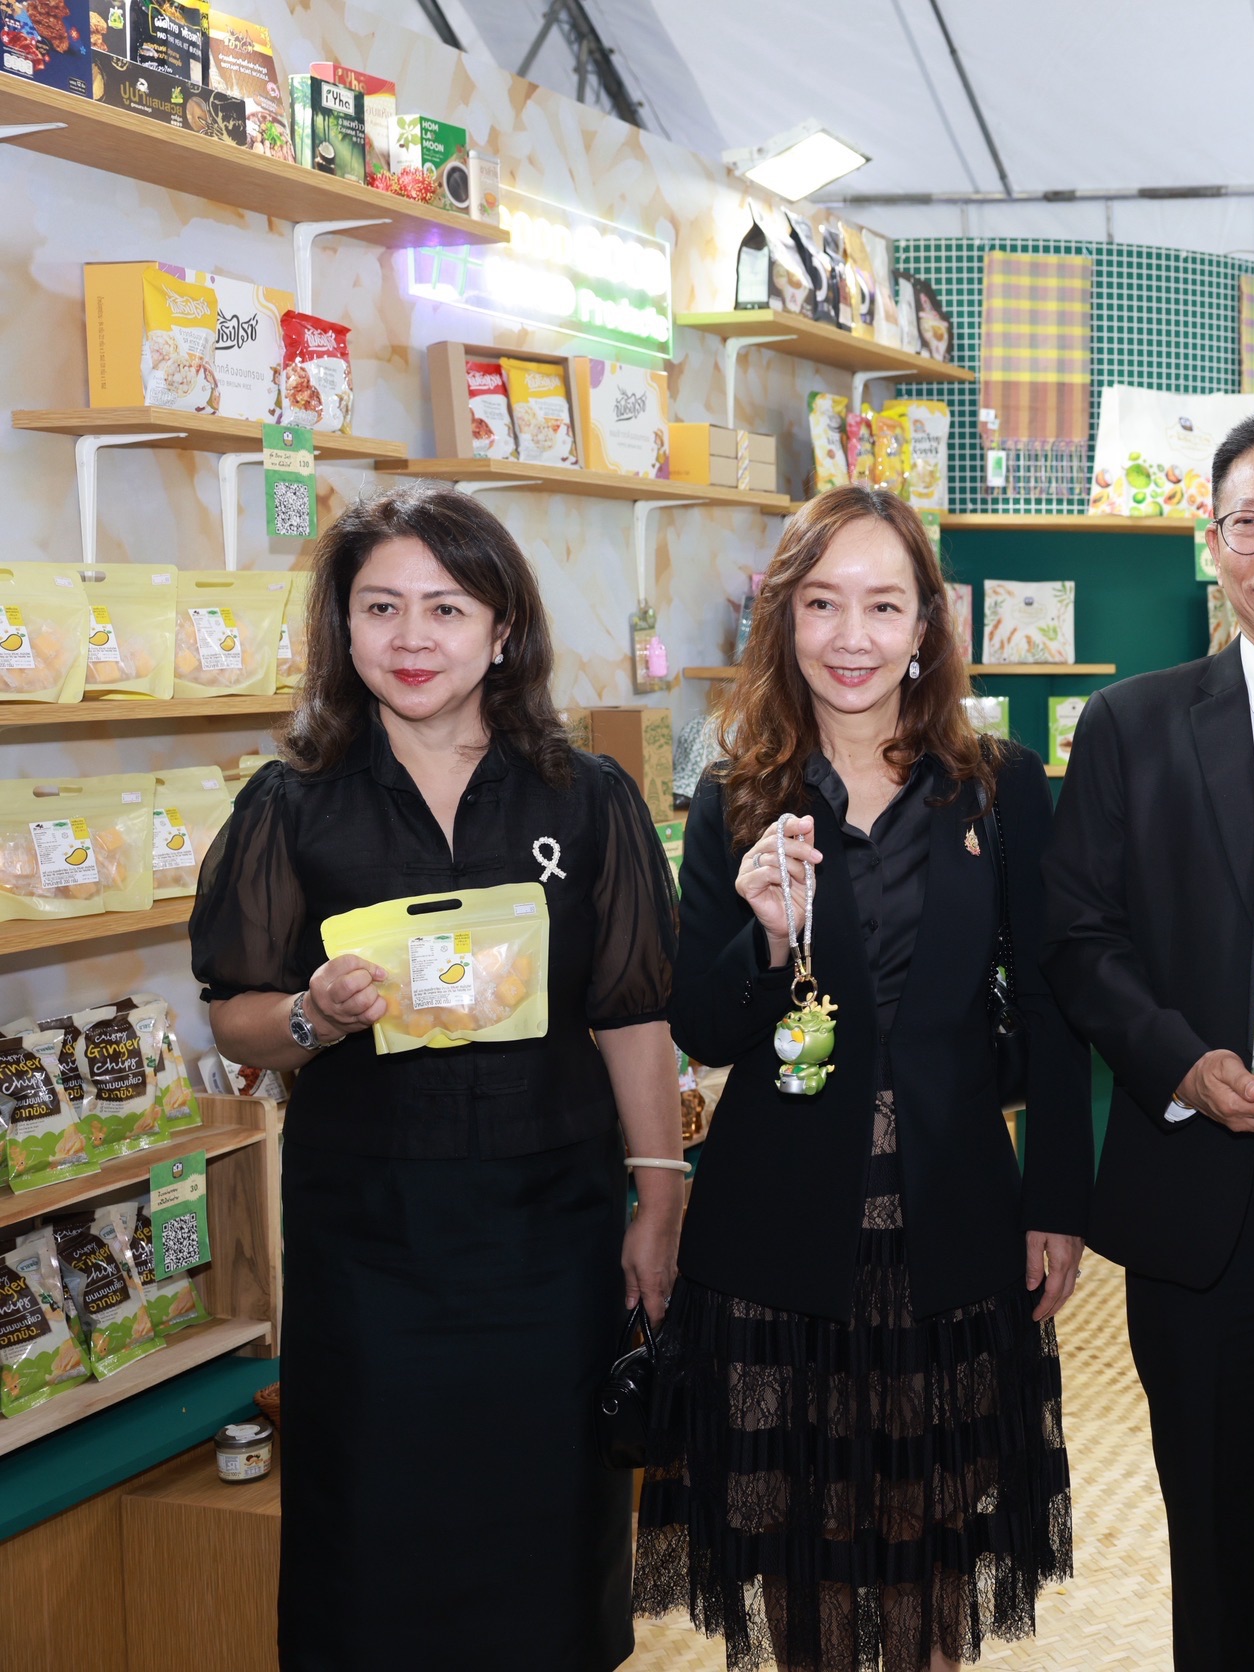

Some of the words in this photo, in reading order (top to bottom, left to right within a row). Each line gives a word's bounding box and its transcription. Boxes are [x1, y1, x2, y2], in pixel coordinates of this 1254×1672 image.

[422, 120, 439, 132] HOM
[422, 140, 444, 152] MOON
[87, 1036, 140, 1060] Ginger
[190, 1183, 198, 1193] 30
[71, 1243, 111, 1271] Ginger
